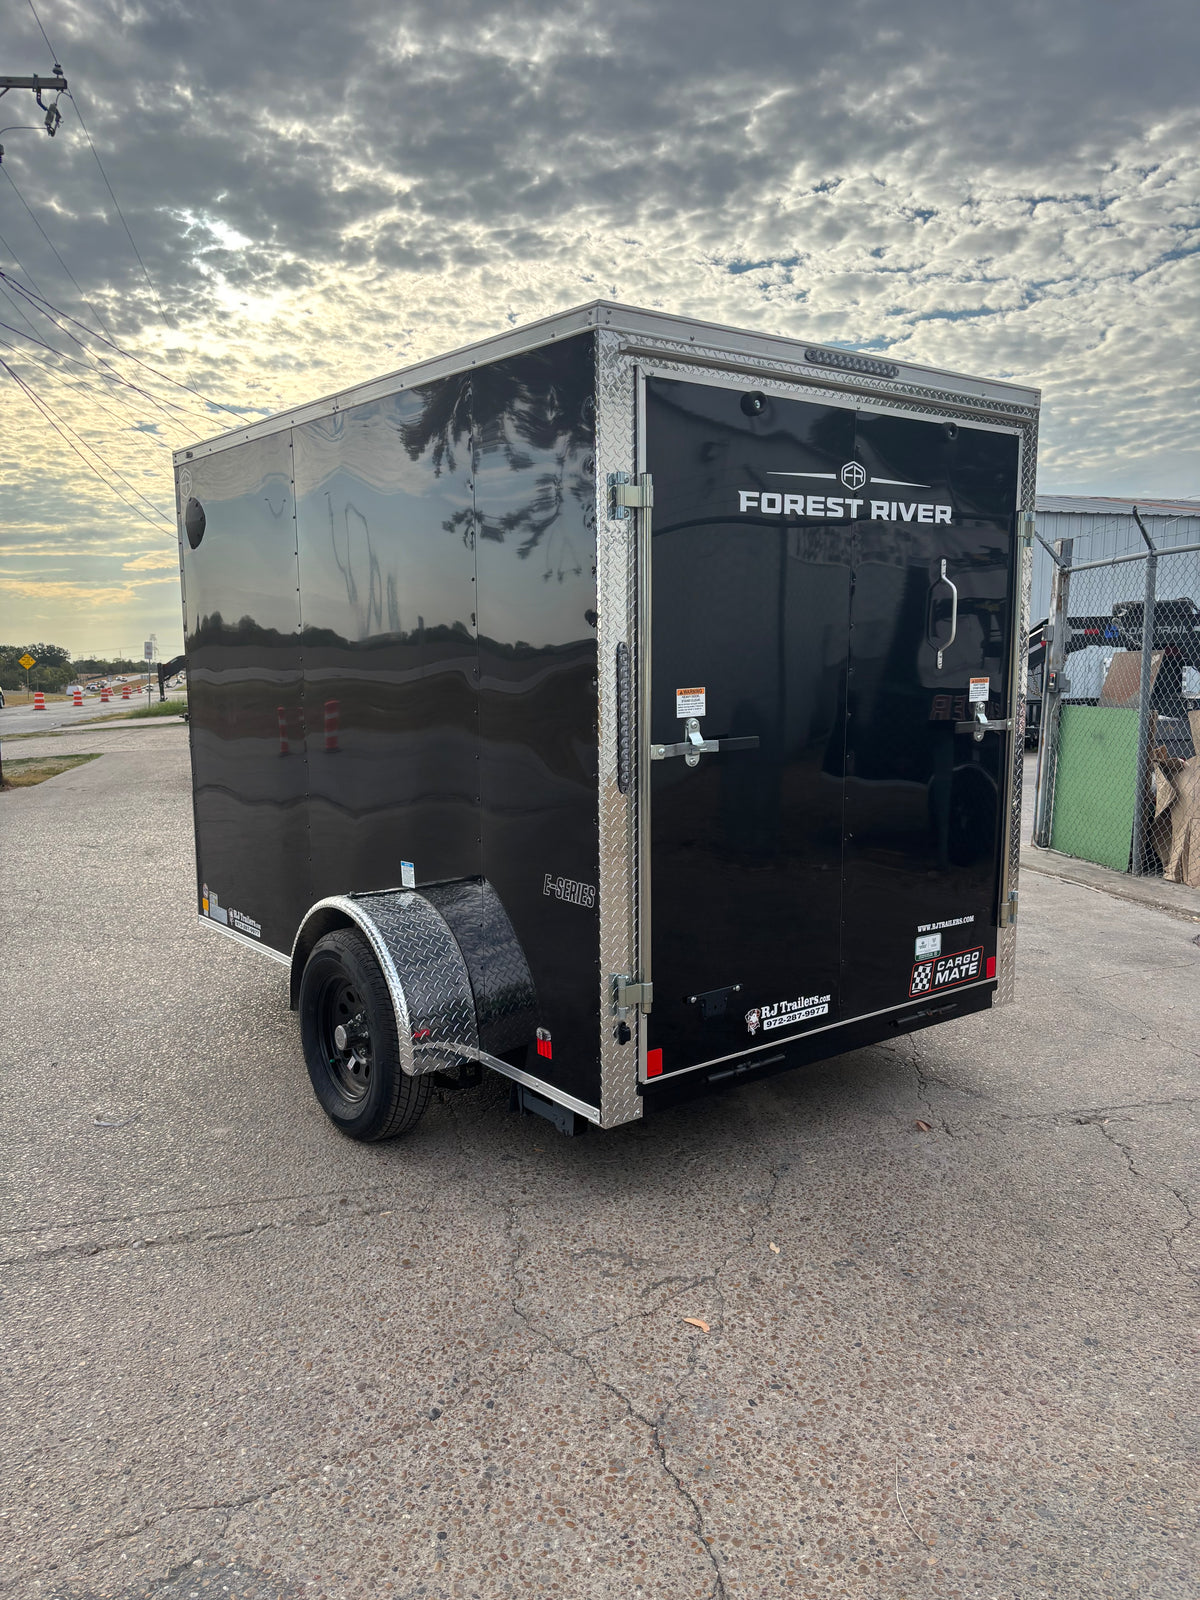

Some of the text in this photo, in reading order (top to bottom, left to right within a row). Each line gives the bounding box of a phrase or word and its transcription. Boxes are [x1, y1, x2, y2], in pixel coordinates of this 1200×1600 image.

[843, 464, 864, 488] FR
[738, 490, 952, 524] FOREST RIVER
[543, 873, 596, 908] E-SERIES
[917, 915, 975, 933] WWW.RJTRAILERS.COM
[937, 951, 980, 971] CARGO
[935, 961, 978, 985] MATE
[761, 1003, 779, 1019] RJ
[766, 1006, 826, 1028] 972-287-9977
